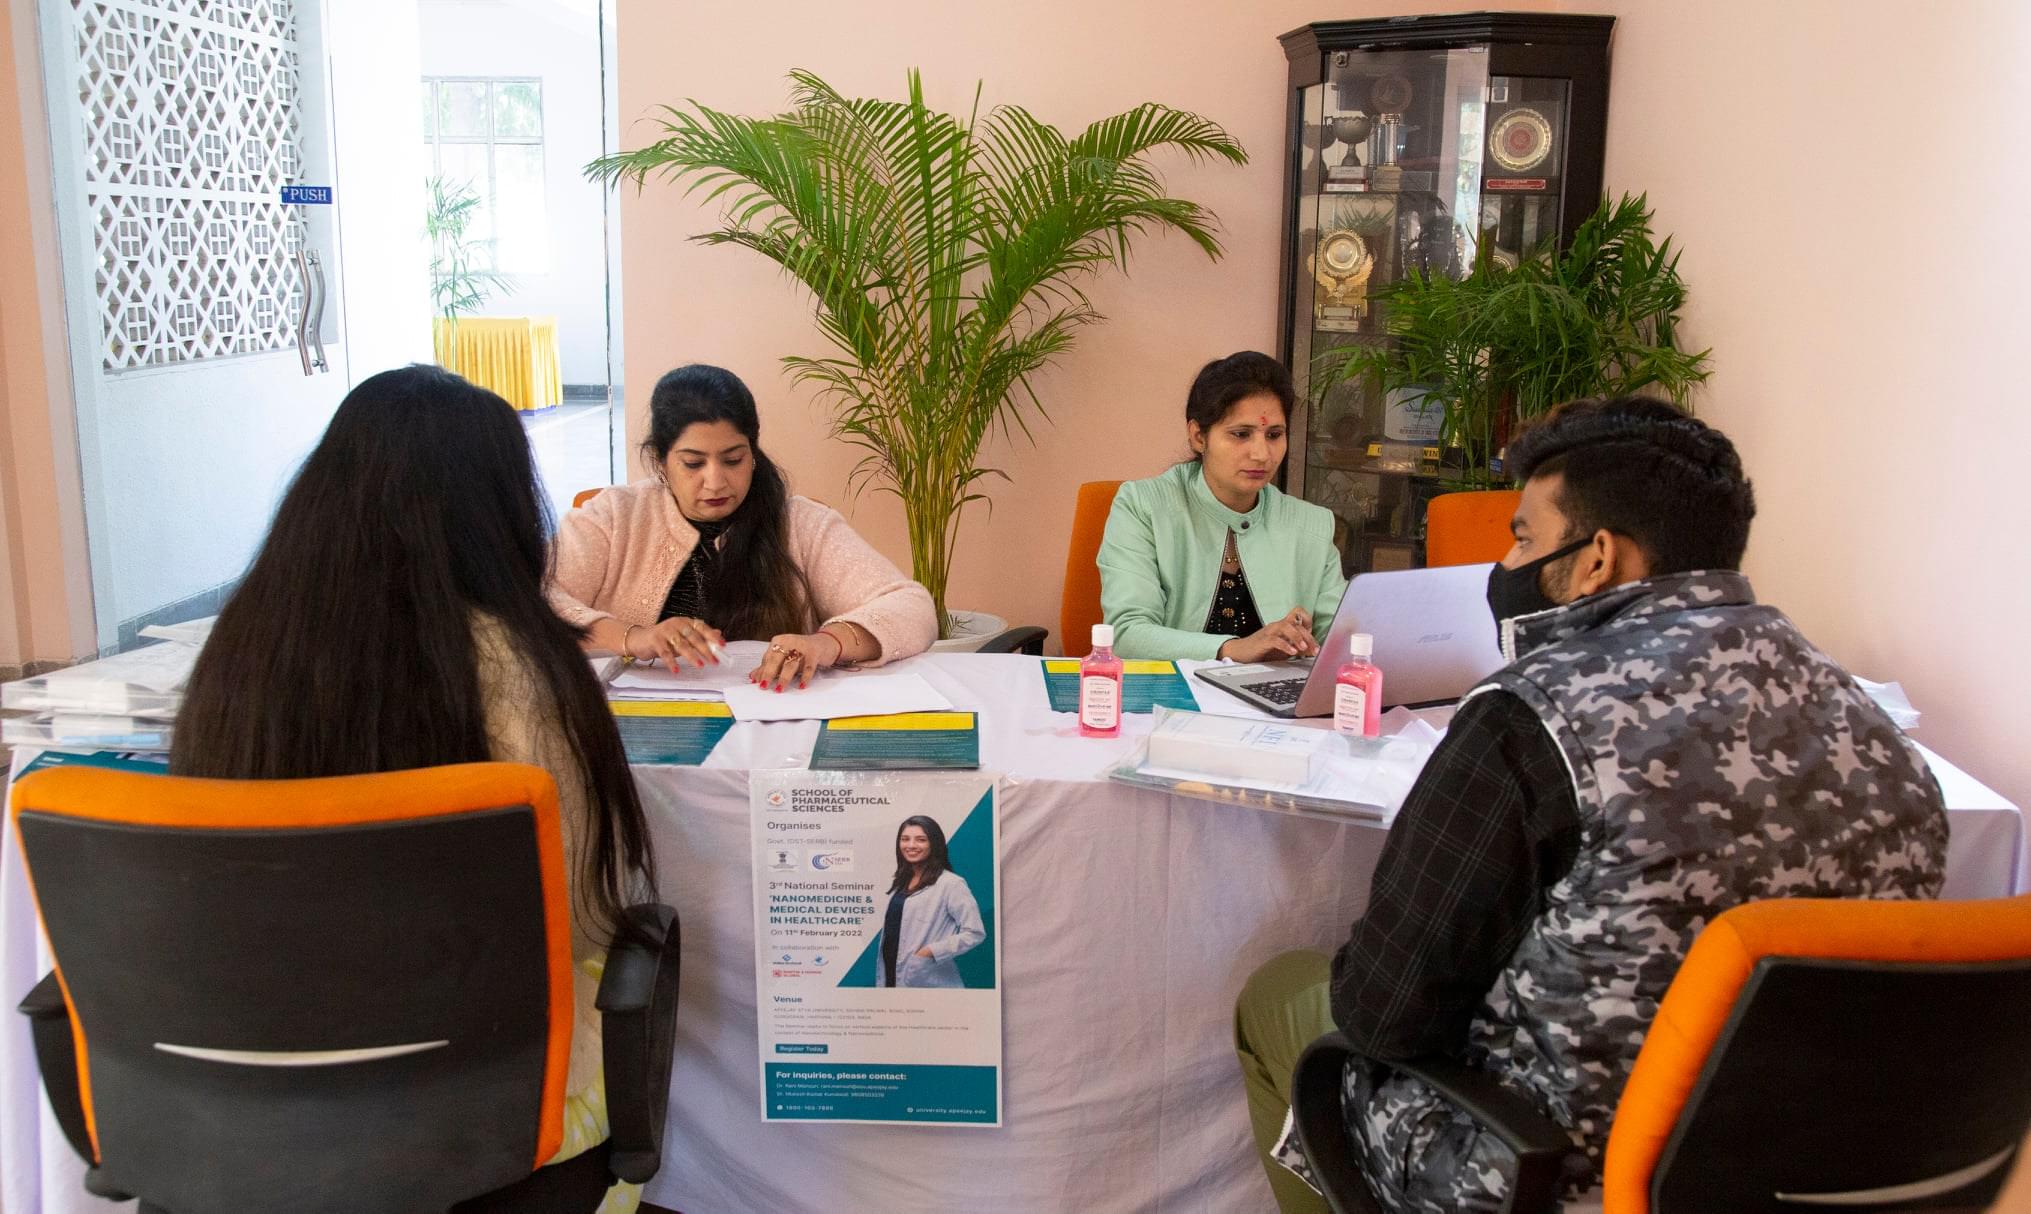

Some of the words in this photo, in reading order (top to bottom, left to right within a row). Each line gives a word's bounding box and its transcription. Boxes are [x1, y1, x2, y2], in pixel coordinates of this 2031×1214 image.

[291, 188, 326, 201] PUSH
[767, 821, 821, 831] Organises
[769, 882, 782, 890] 3rd
[784, 882, 828, 890] National
[831, 882, 874, 891] Seminar
[836, 1072, 867, 1080] please
